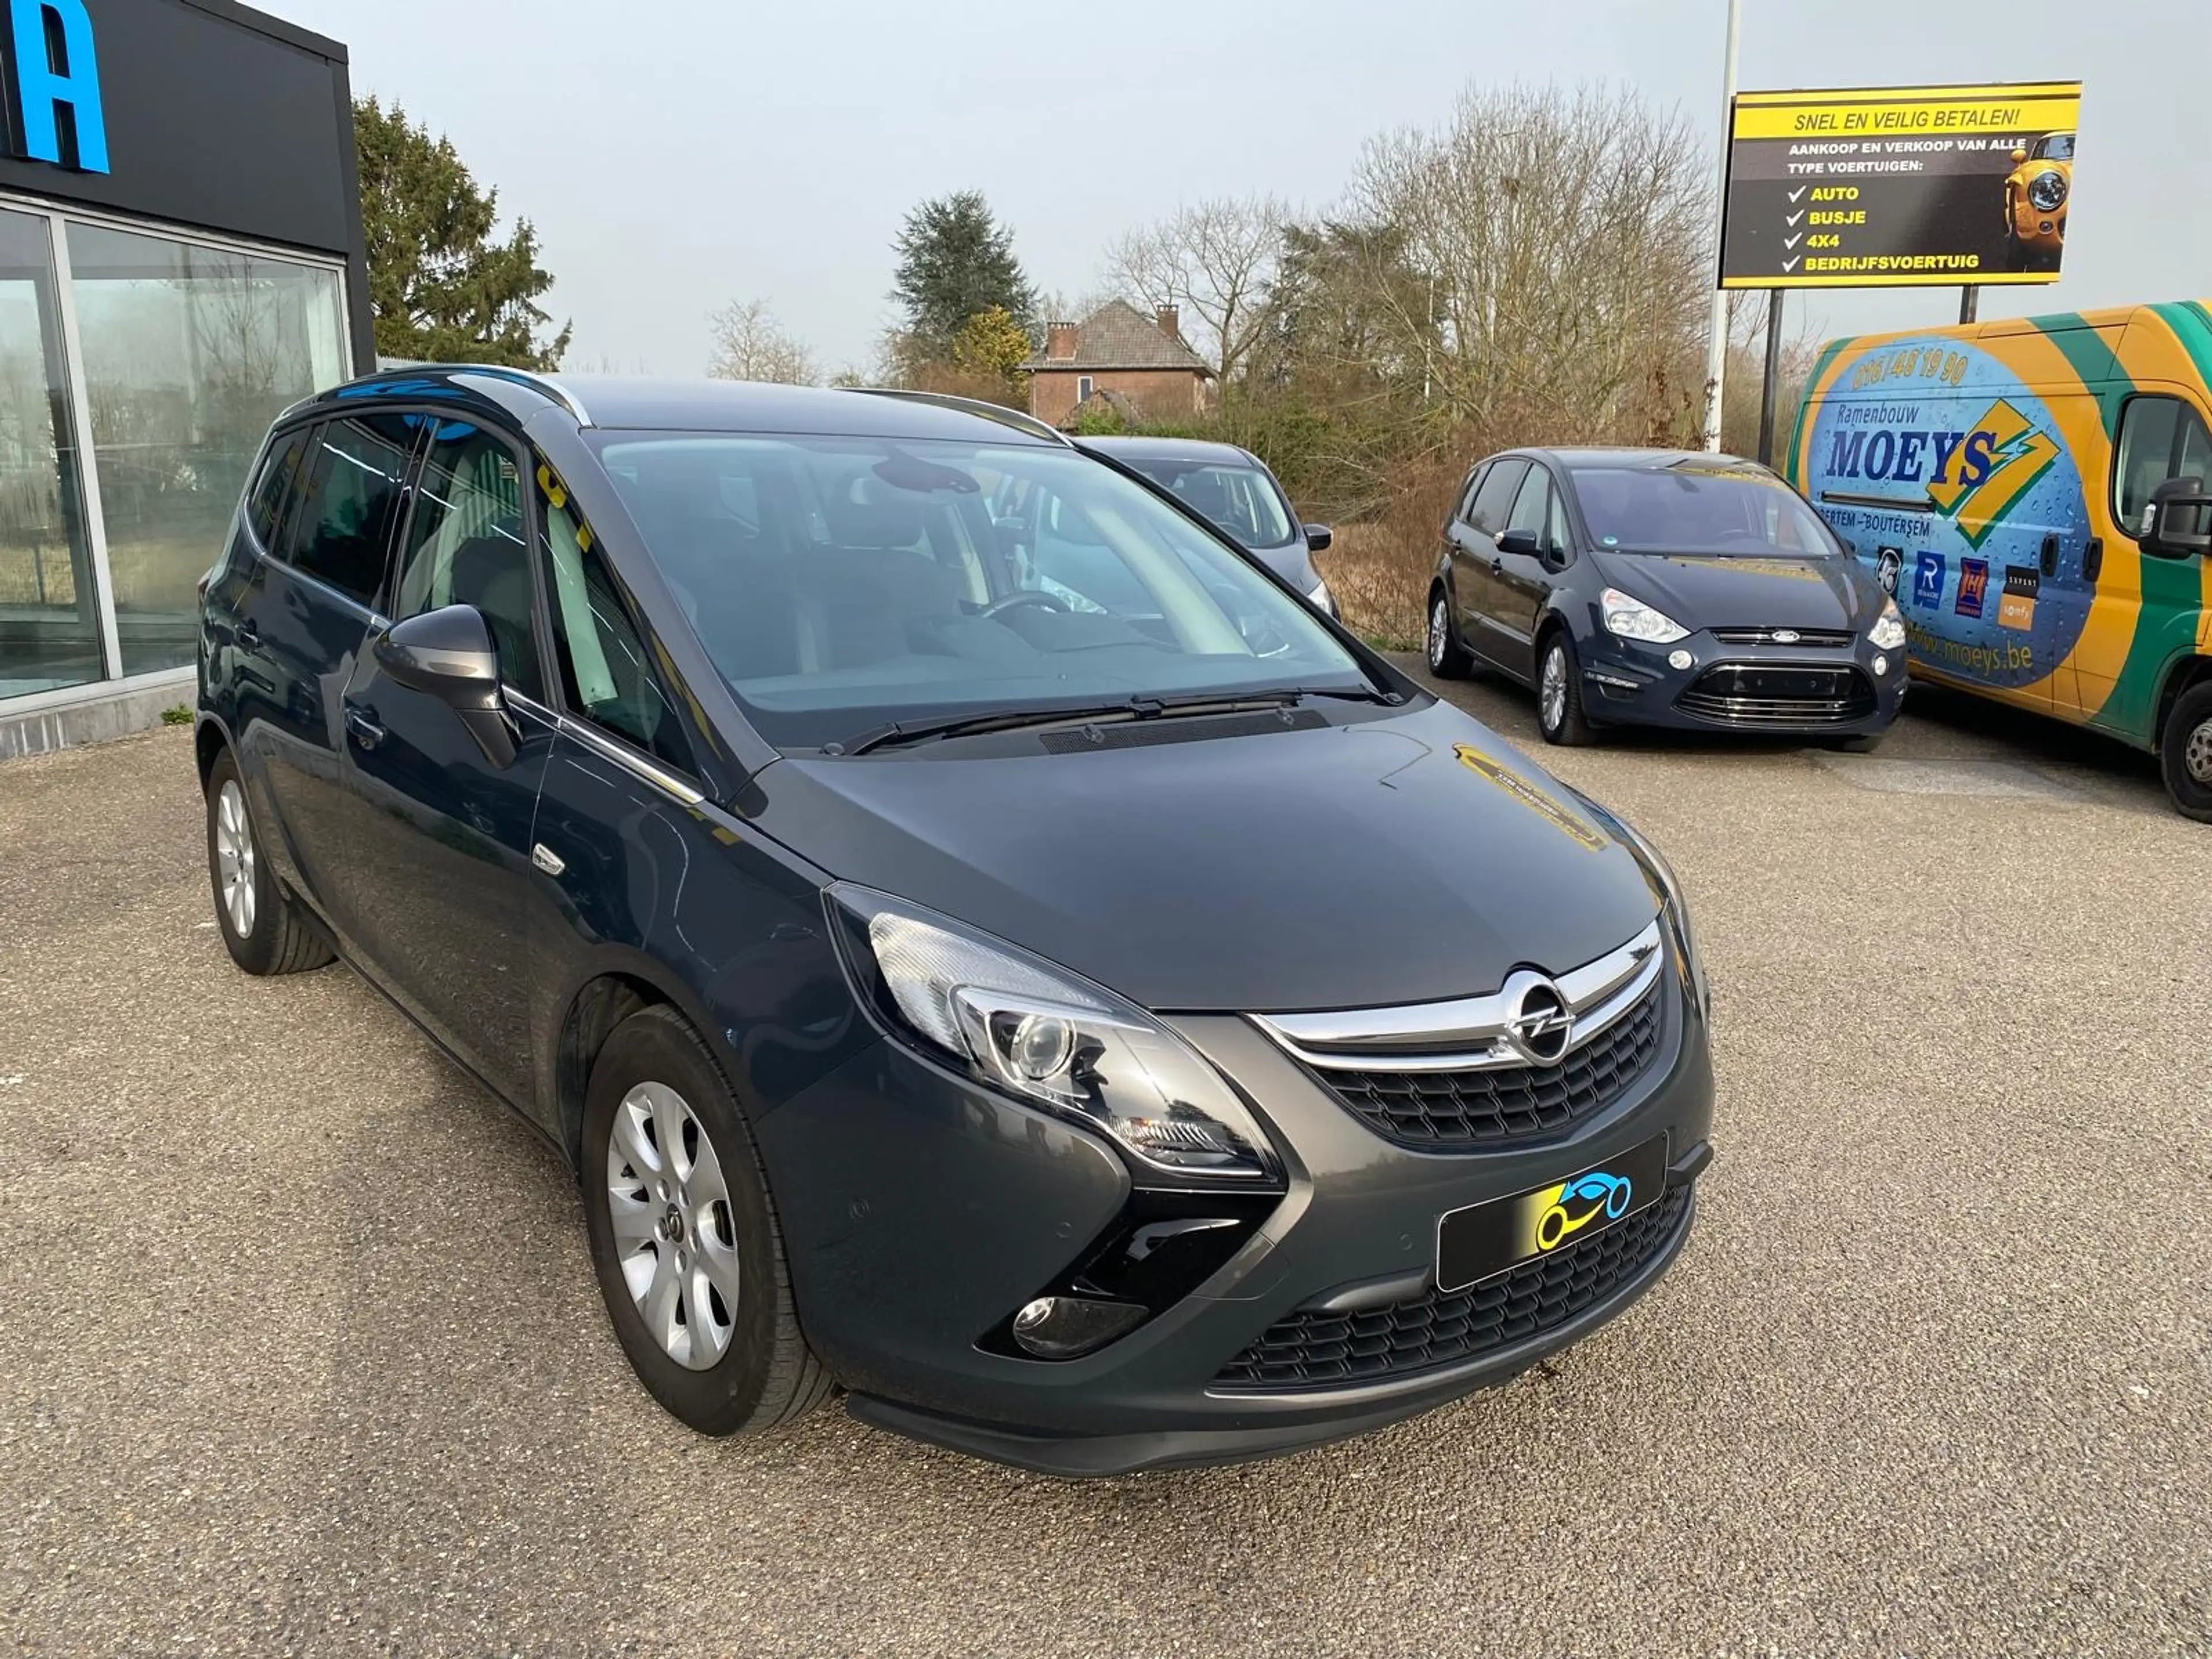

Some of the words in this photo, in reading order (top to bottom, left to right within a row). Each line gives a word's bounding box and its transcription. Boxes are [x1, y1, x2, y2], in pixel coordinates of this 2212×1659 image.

[1794, 114, 1838, 131] SNEL
[1844, 113, 1868, 130] EN
[1874, 111, 1929, 128] VEILIG
[1933, 109, 2021, 127] BETALEN!
[1789, 143, 1858, 156] AANKOOP
[1861, 143, 1881, 153] EN
[1885, 141, 1953, 152] VERKOOP
[1958, 139, 1986, 150] VAN
[1989, 138, 2027, 150] ALLE
[1787, 163, 1825, 174] TYPE
[1827, 161, 1924, 173] VOERTUIGEN:
[1810, 187, 1859, 201] AUTO
[1808, 211, 1866, 225] BUSJE
[1806, 234, 1840, 248] 4X4
[1805, 255, 1979, 271] BEDRIJFSVOERTUIG
[1837, 402, 1920, 424] Ramenbouw
[1826, 430, 1997, 487] MOEYS
[1865, 513, 1930, 537] BOUTERSEM
